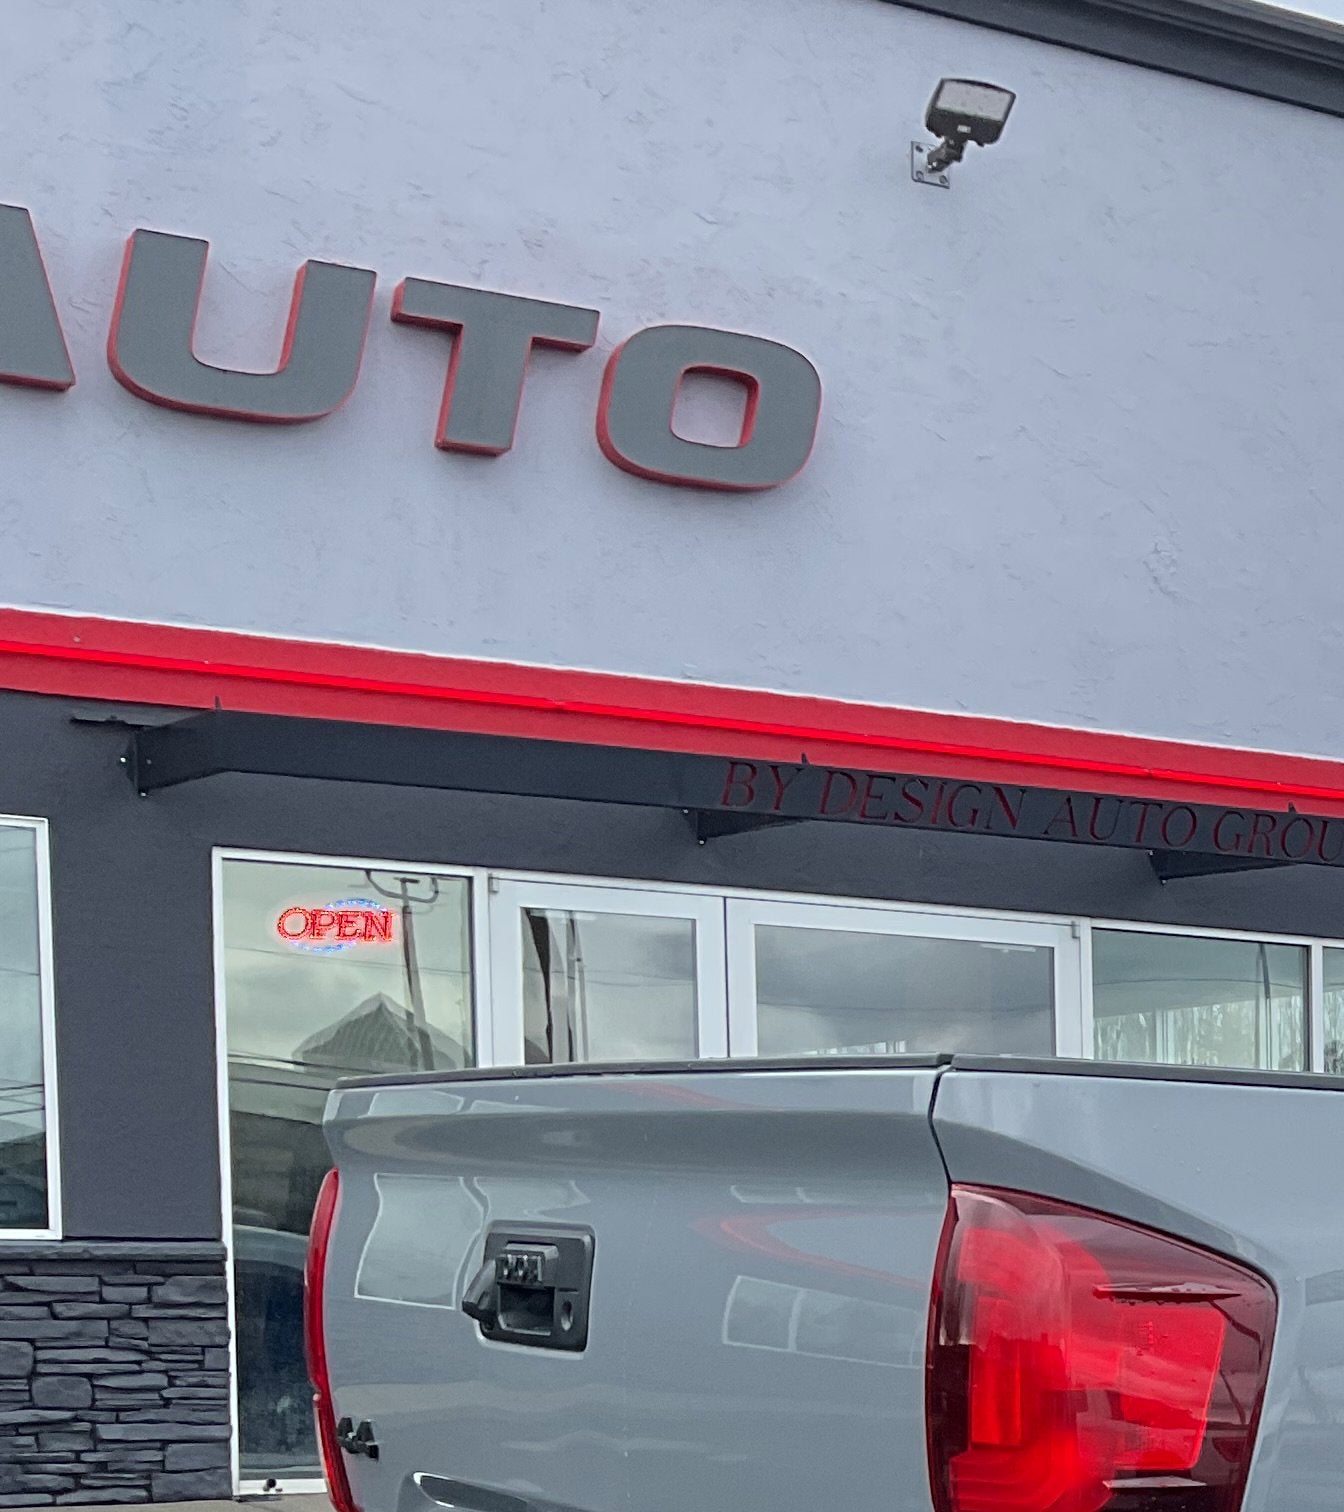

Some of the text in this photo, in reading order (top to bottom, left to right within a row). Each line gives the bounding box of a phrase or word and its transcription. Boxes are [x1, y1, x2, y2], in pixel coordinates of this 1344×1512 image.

[720, 759, 804, 811] BY
[818, 767, 1027, 832] DESIGN
[1046, 795, 1199, 848] AUTO
[277, 906, 395, 943] OPEN
